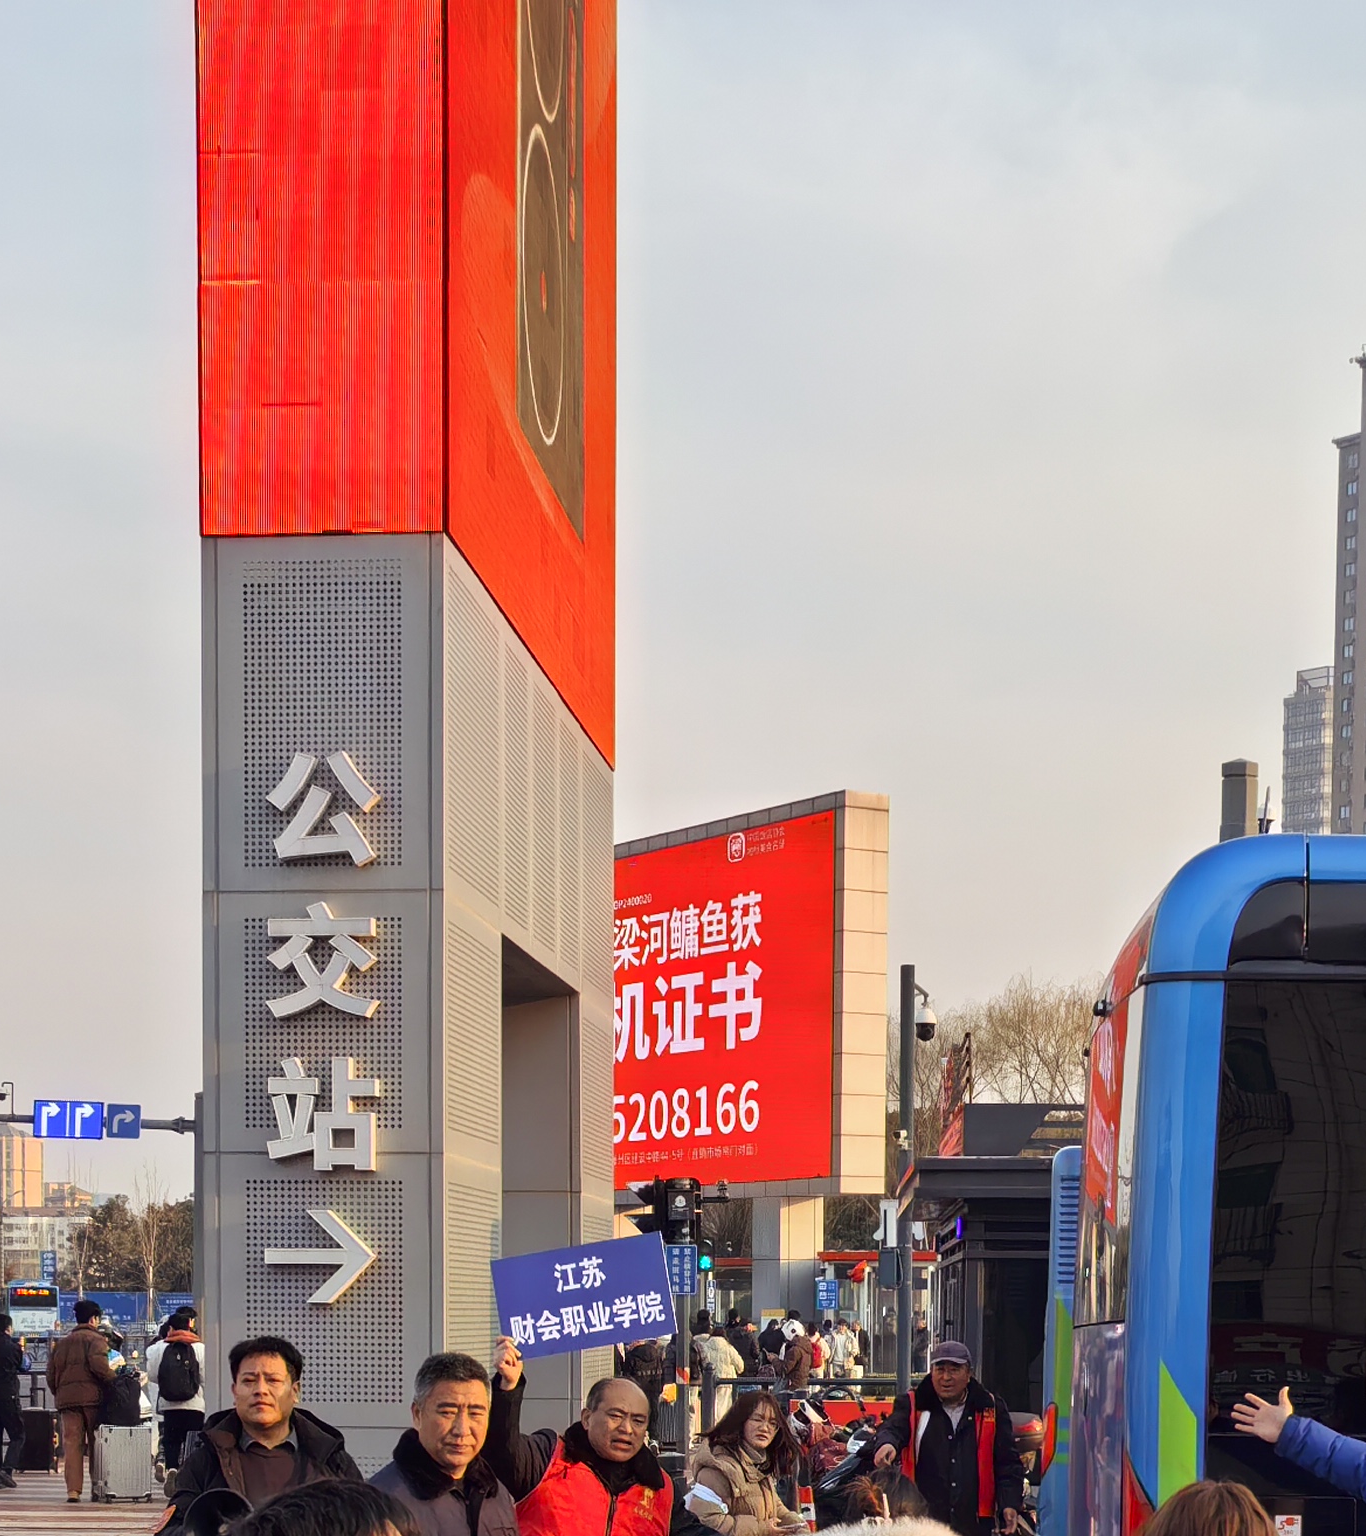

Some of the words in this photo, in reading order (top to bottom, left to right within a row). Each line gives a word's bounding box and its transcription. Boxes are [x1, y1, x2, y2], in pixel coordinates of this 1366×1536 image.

[265, 750, 380, 1171] 公交站
[613, 960, 763, 1064] 机证书
[613, 1080, 760, 1144] 5208166
[554, 1255, 607, 1293] 江苏
[509, 1290, 666, 1346] 财会职业学院
